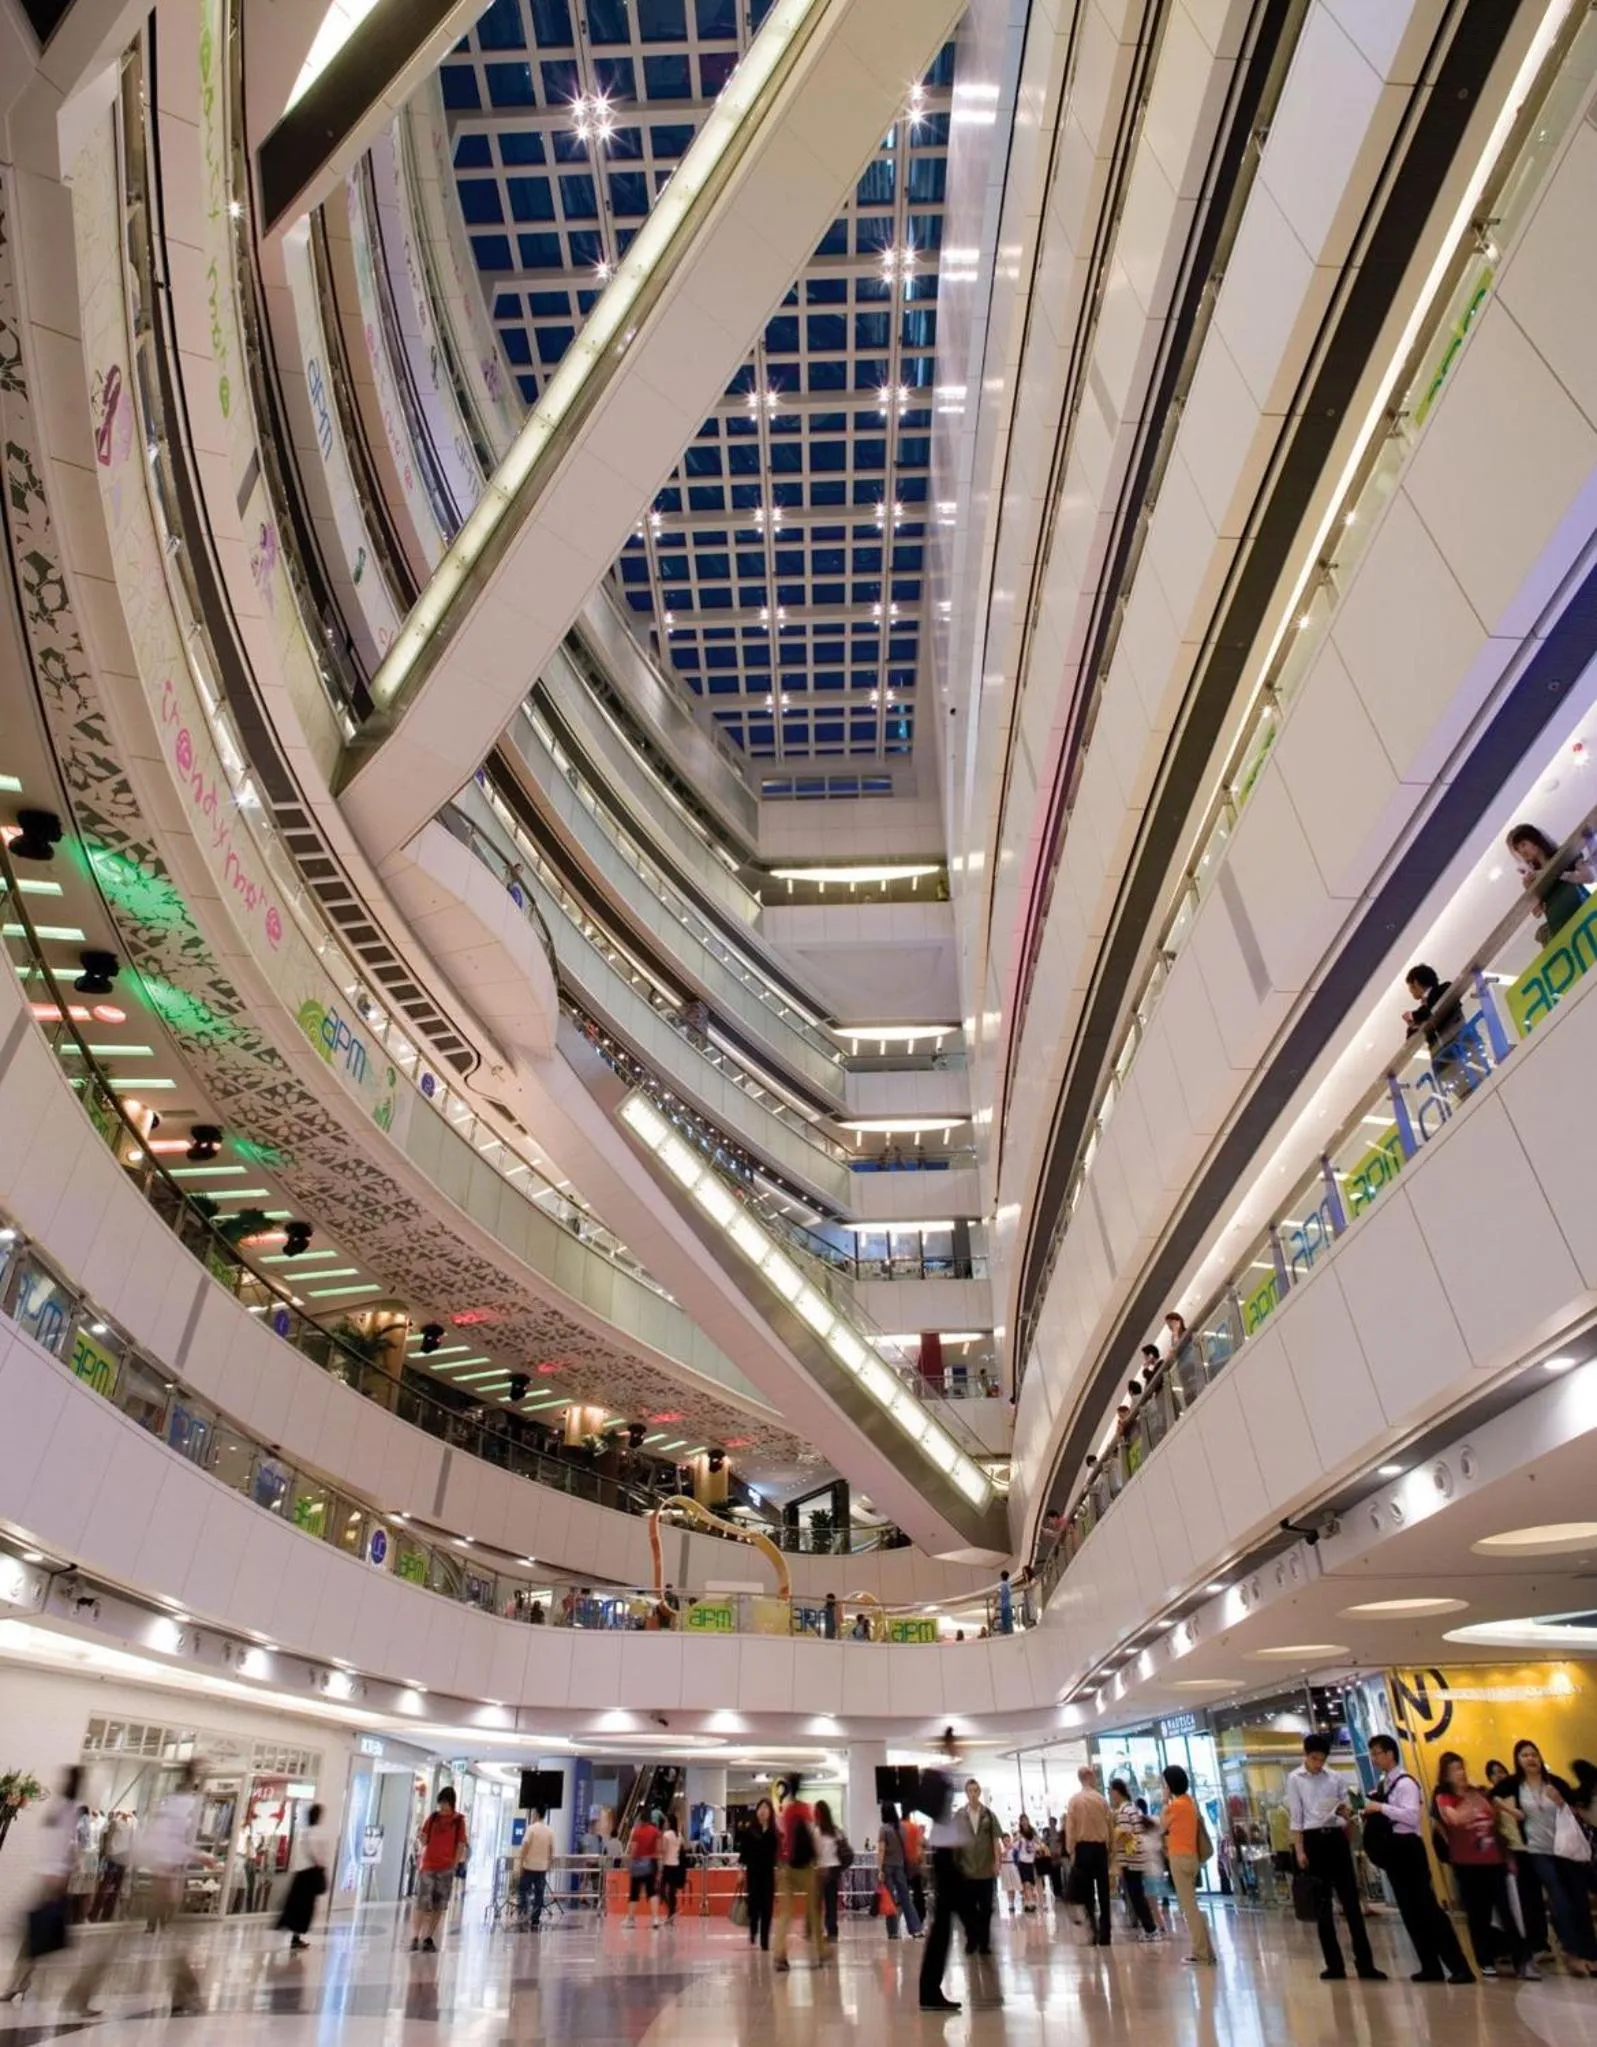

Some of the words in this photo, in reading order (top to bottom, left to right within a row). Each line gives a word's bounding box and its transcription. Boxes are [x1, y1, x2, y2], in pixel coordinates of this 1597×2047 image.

[321, 1005, 366, 1084] apm
[688, 1605, 732, 1629] apm
[890, 1620, 936, 1644] apm
